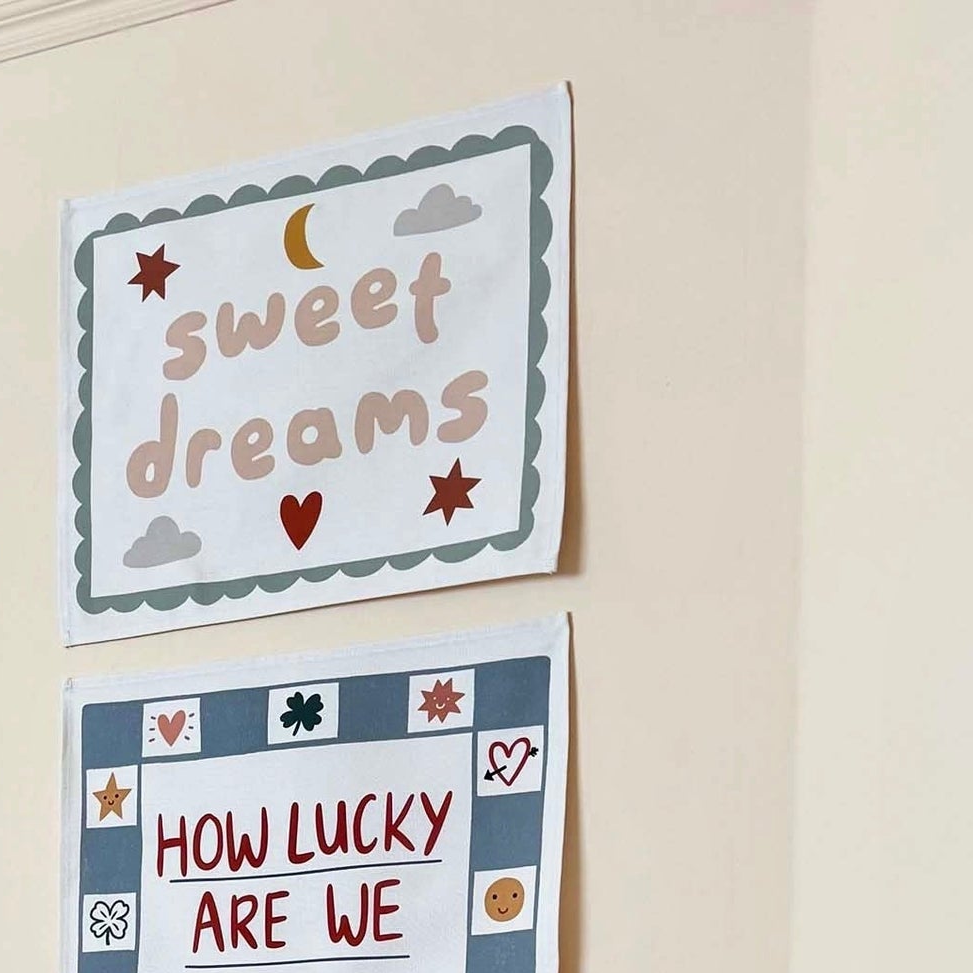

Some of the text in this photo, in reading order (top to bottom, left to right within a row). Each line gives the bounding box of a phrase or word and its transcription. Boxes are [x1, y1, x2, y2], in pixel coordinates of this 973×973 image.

[163, 252, 451, 380] sweet
[126, 370, 489, 498] dreams
[157, 790, 454, 878] HOW LUCKY
[192, 878, 404, 954] ARE WE
